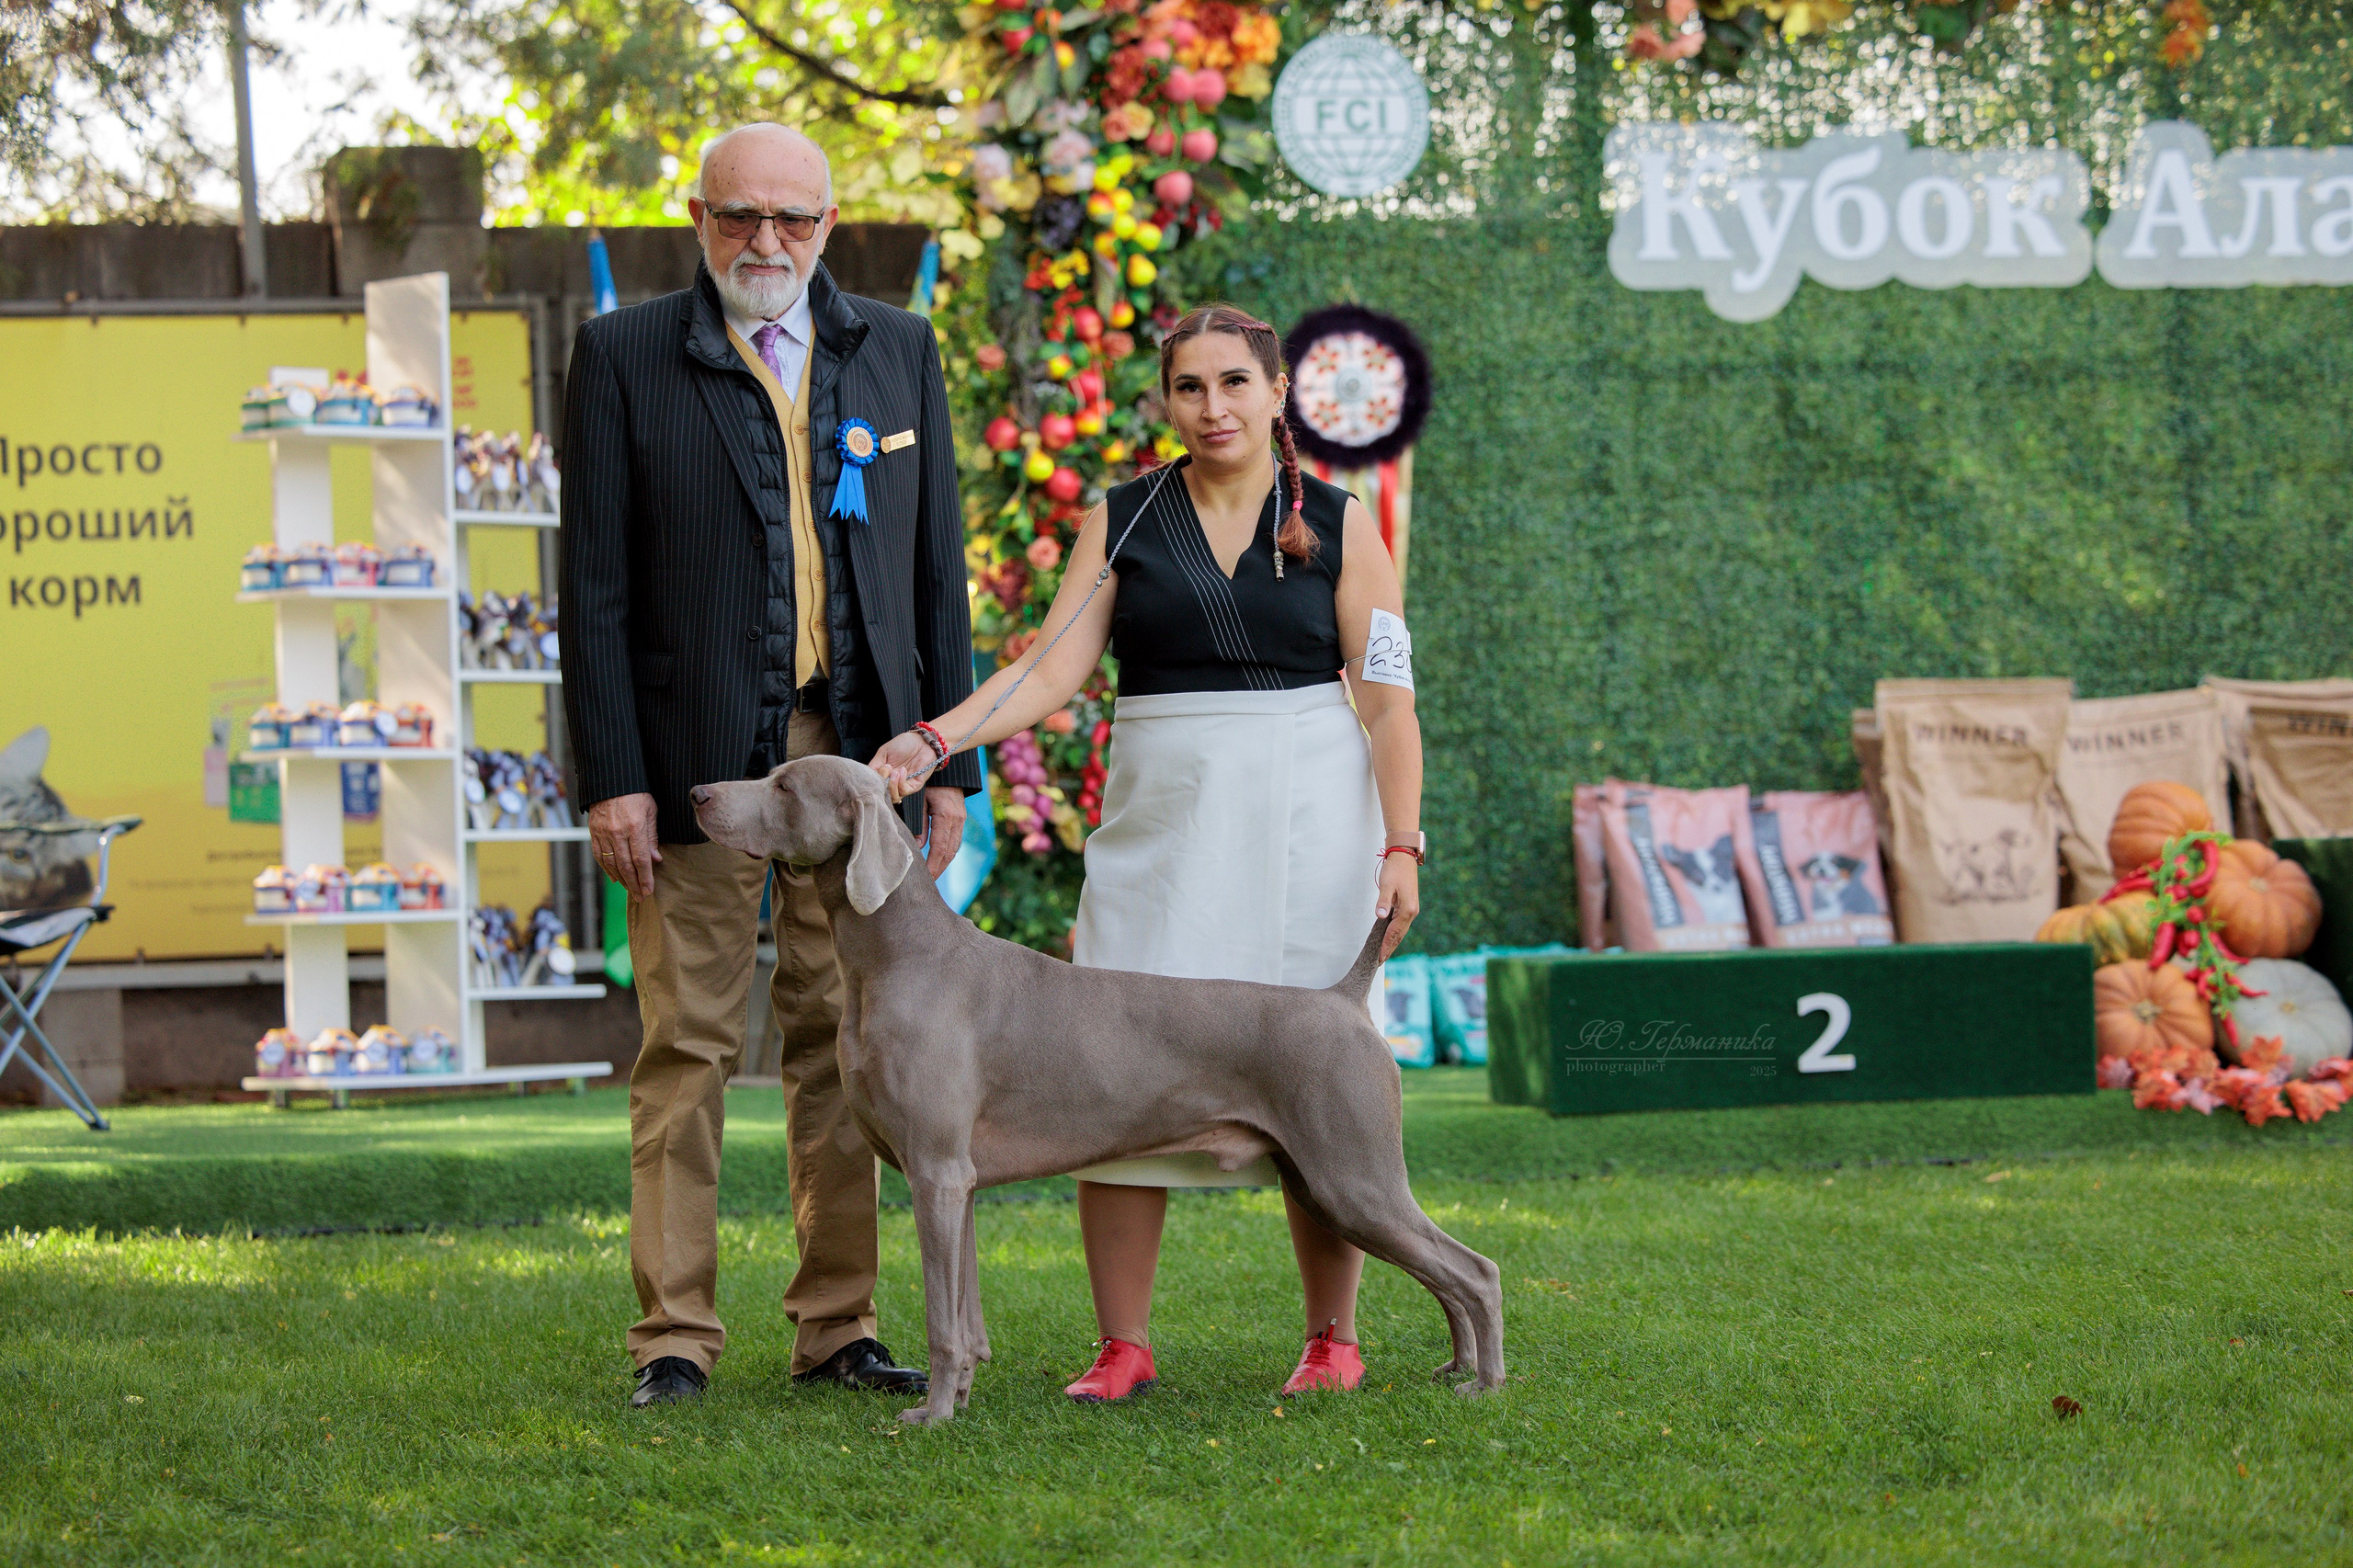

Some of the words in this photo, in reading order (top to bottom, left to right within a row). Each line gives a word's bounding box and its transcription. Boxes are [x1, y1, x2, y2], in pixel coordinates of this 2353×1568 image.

[1316, 99, 1386, 131] FCI
[1636, 143, 2067, 293] Кубок
[10, 574, 142, 618] корм
[1914, 722, 2027, 745] WINNER
[2066, 722, 2183, 752] WINNER
[2288, 714, 2353, 737] WIN
[1797, 992, 1857, 1074] 2
